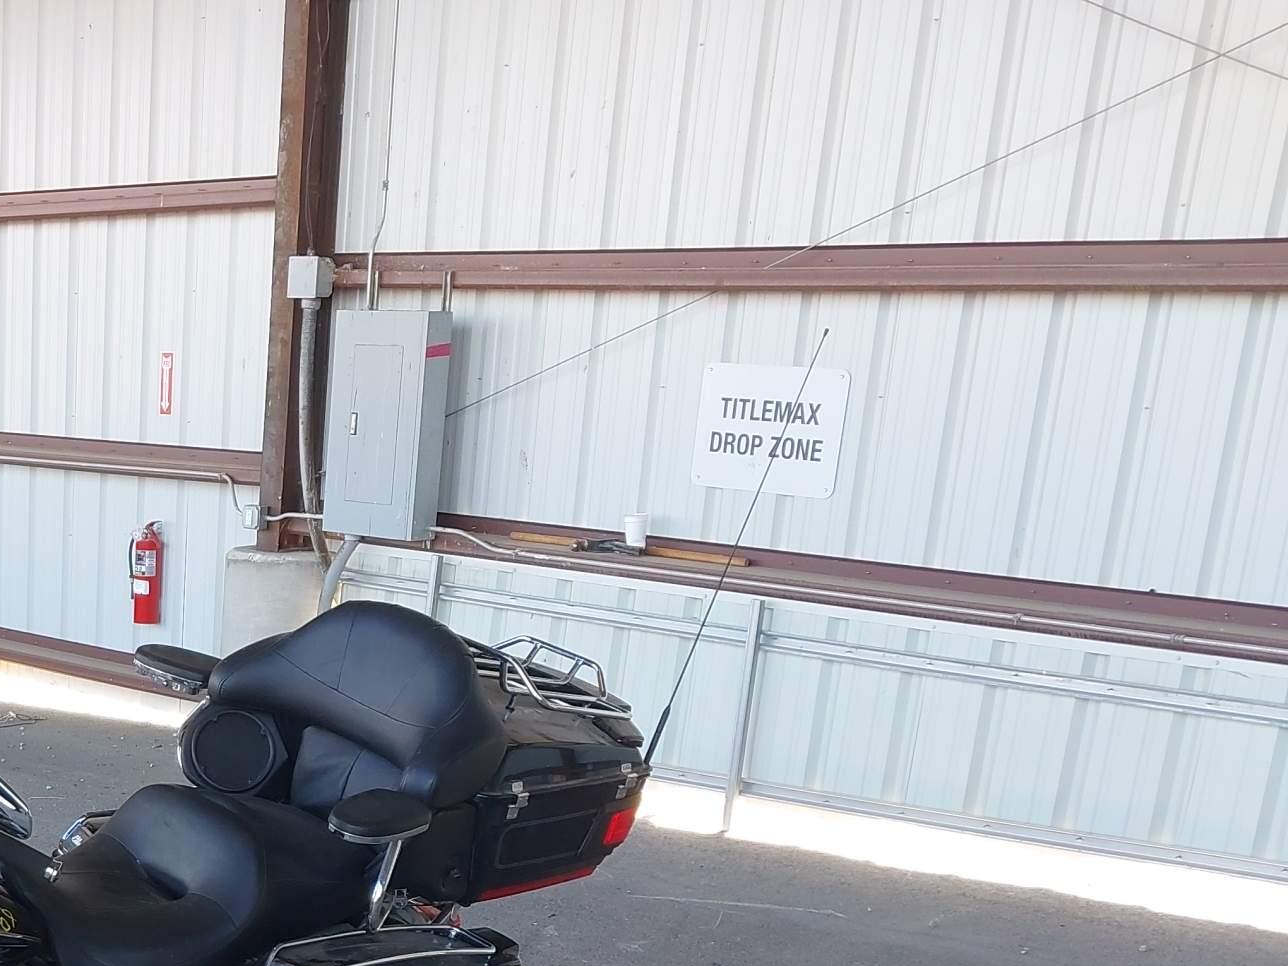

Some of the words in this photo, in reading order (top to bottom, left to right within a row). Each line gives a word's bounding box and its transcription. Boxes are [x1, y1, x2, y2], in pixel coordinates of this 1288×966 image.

[721, 397, 822, 426] TITLEMAX
[709, 431, 763, 456] DROP
[768, 436, 824, 462] ZONE
